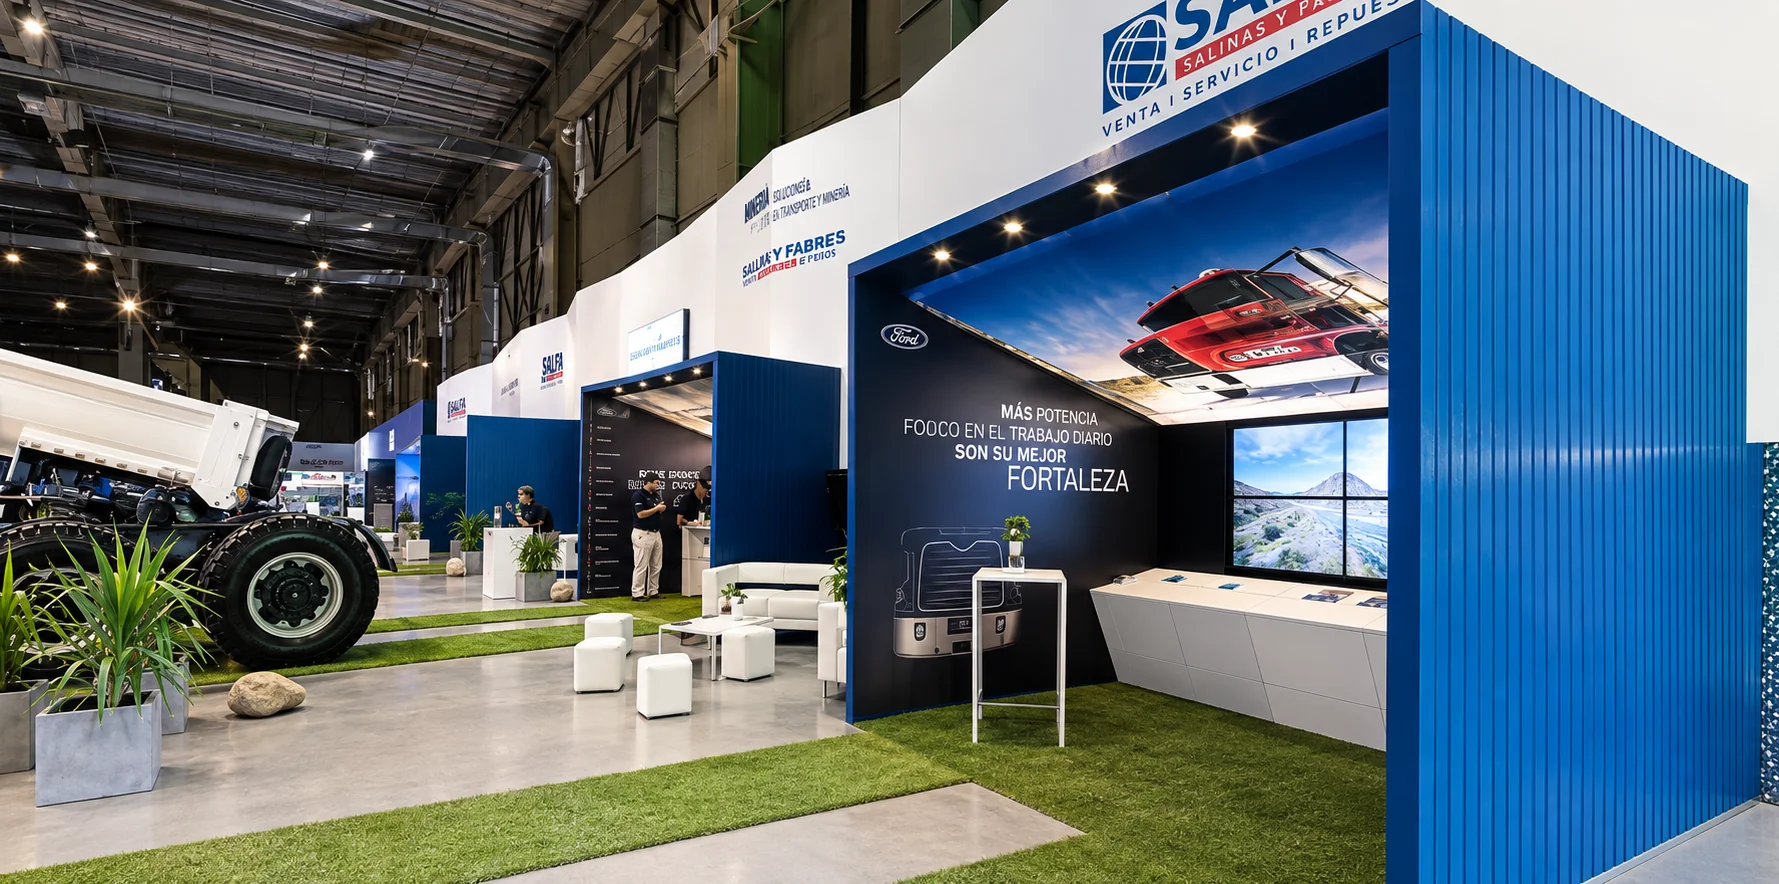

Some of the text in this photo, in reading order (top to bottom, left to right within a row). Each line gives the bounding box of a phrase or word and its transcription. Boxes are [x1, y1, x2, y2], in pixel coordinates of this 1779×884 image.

[1174, 0, 1292, 50] SA
[1183, 0, 1332, 72] SALINAS Y PA
[1102, 102, 1160, 137] VENTA
[1183, 47, 1278, 101] SERVICIO
[772, 246, 782, 261] Y
[785, 229, 846, 258] FABRES
[1001, 402, 1098, 426] MÁS POTENCIA
[964, 422, 985, 439] EN
[989, 424, 1006, 440] EL
[1009, 426, 1070, 444] TRABAJO
[1073, 430, 1113, 447] DIARIO
[954, 444, 1067, 463] SON SU MEJOR
[1007, 464, 1130, 493] FORTALEZA
